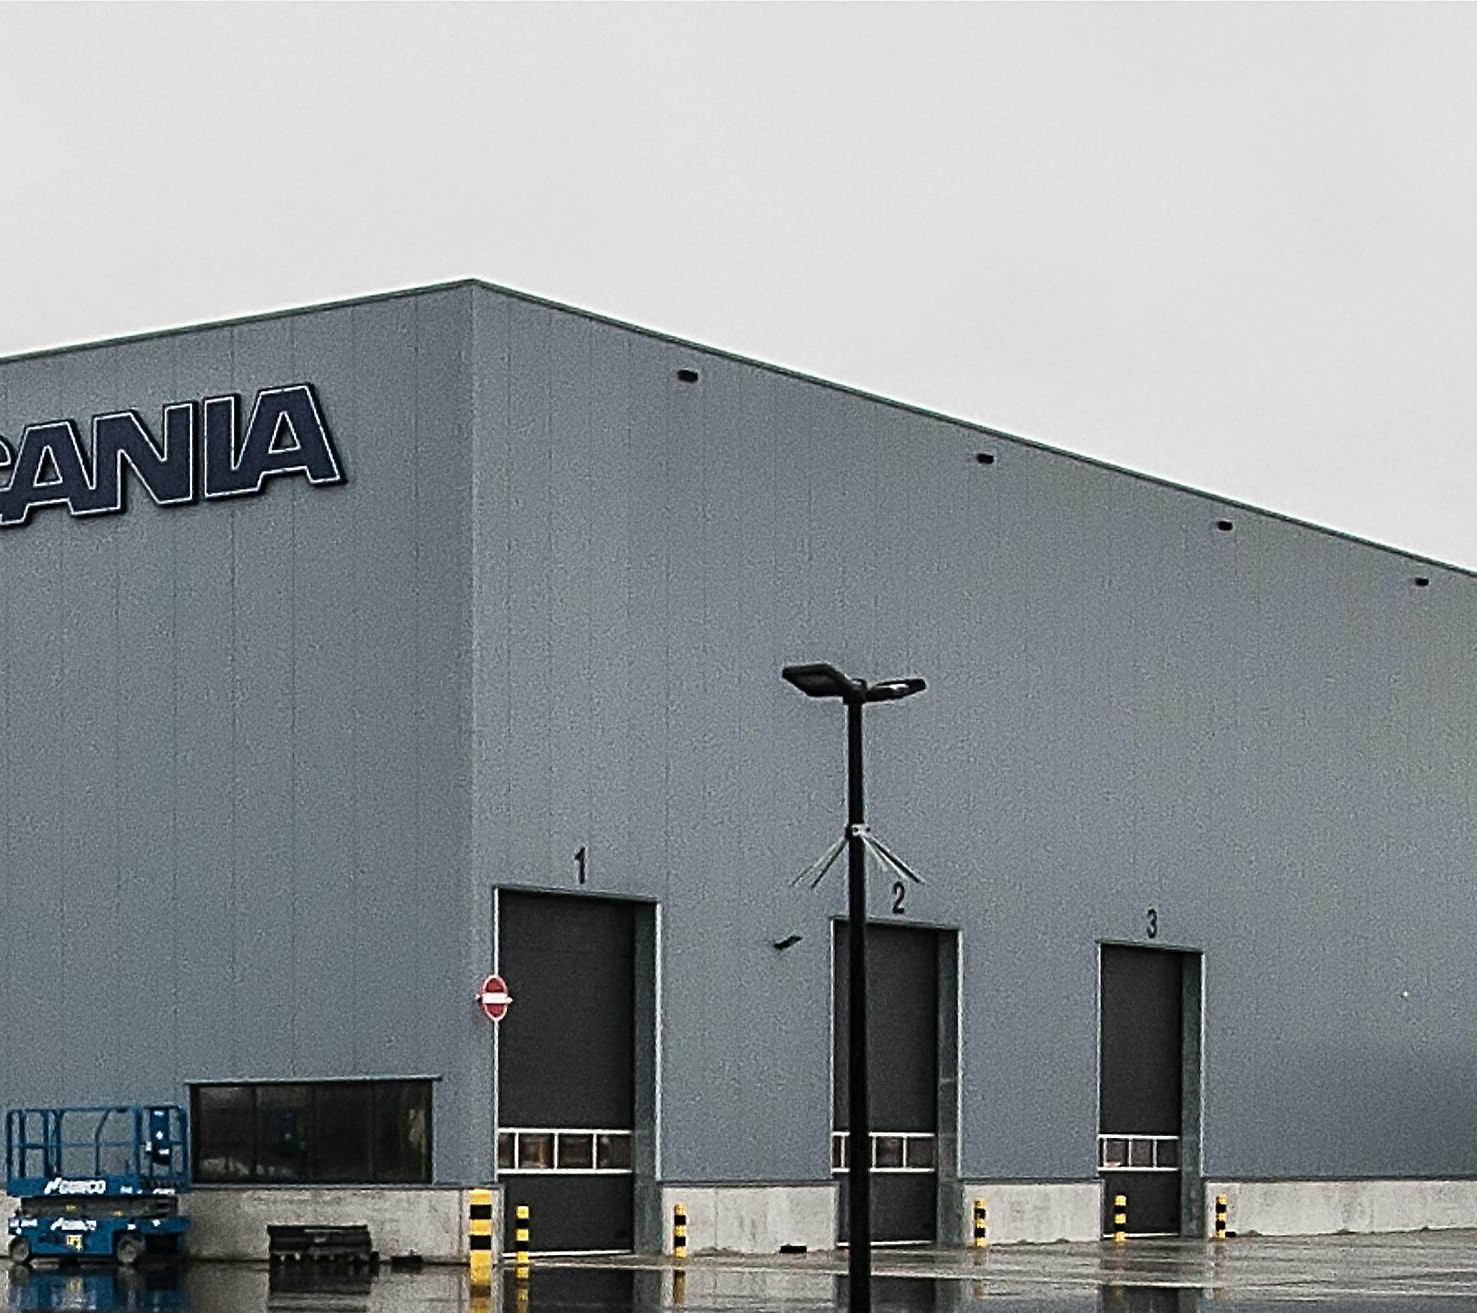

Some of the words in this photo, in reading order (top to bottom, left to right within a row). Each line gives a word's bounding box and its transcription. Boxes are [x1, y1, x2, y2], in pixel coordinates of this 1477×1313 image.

[574, 847, 585, 884] 1
[892, 881, 905, 914] 2
[1146, 908, 1158, 939] 3
